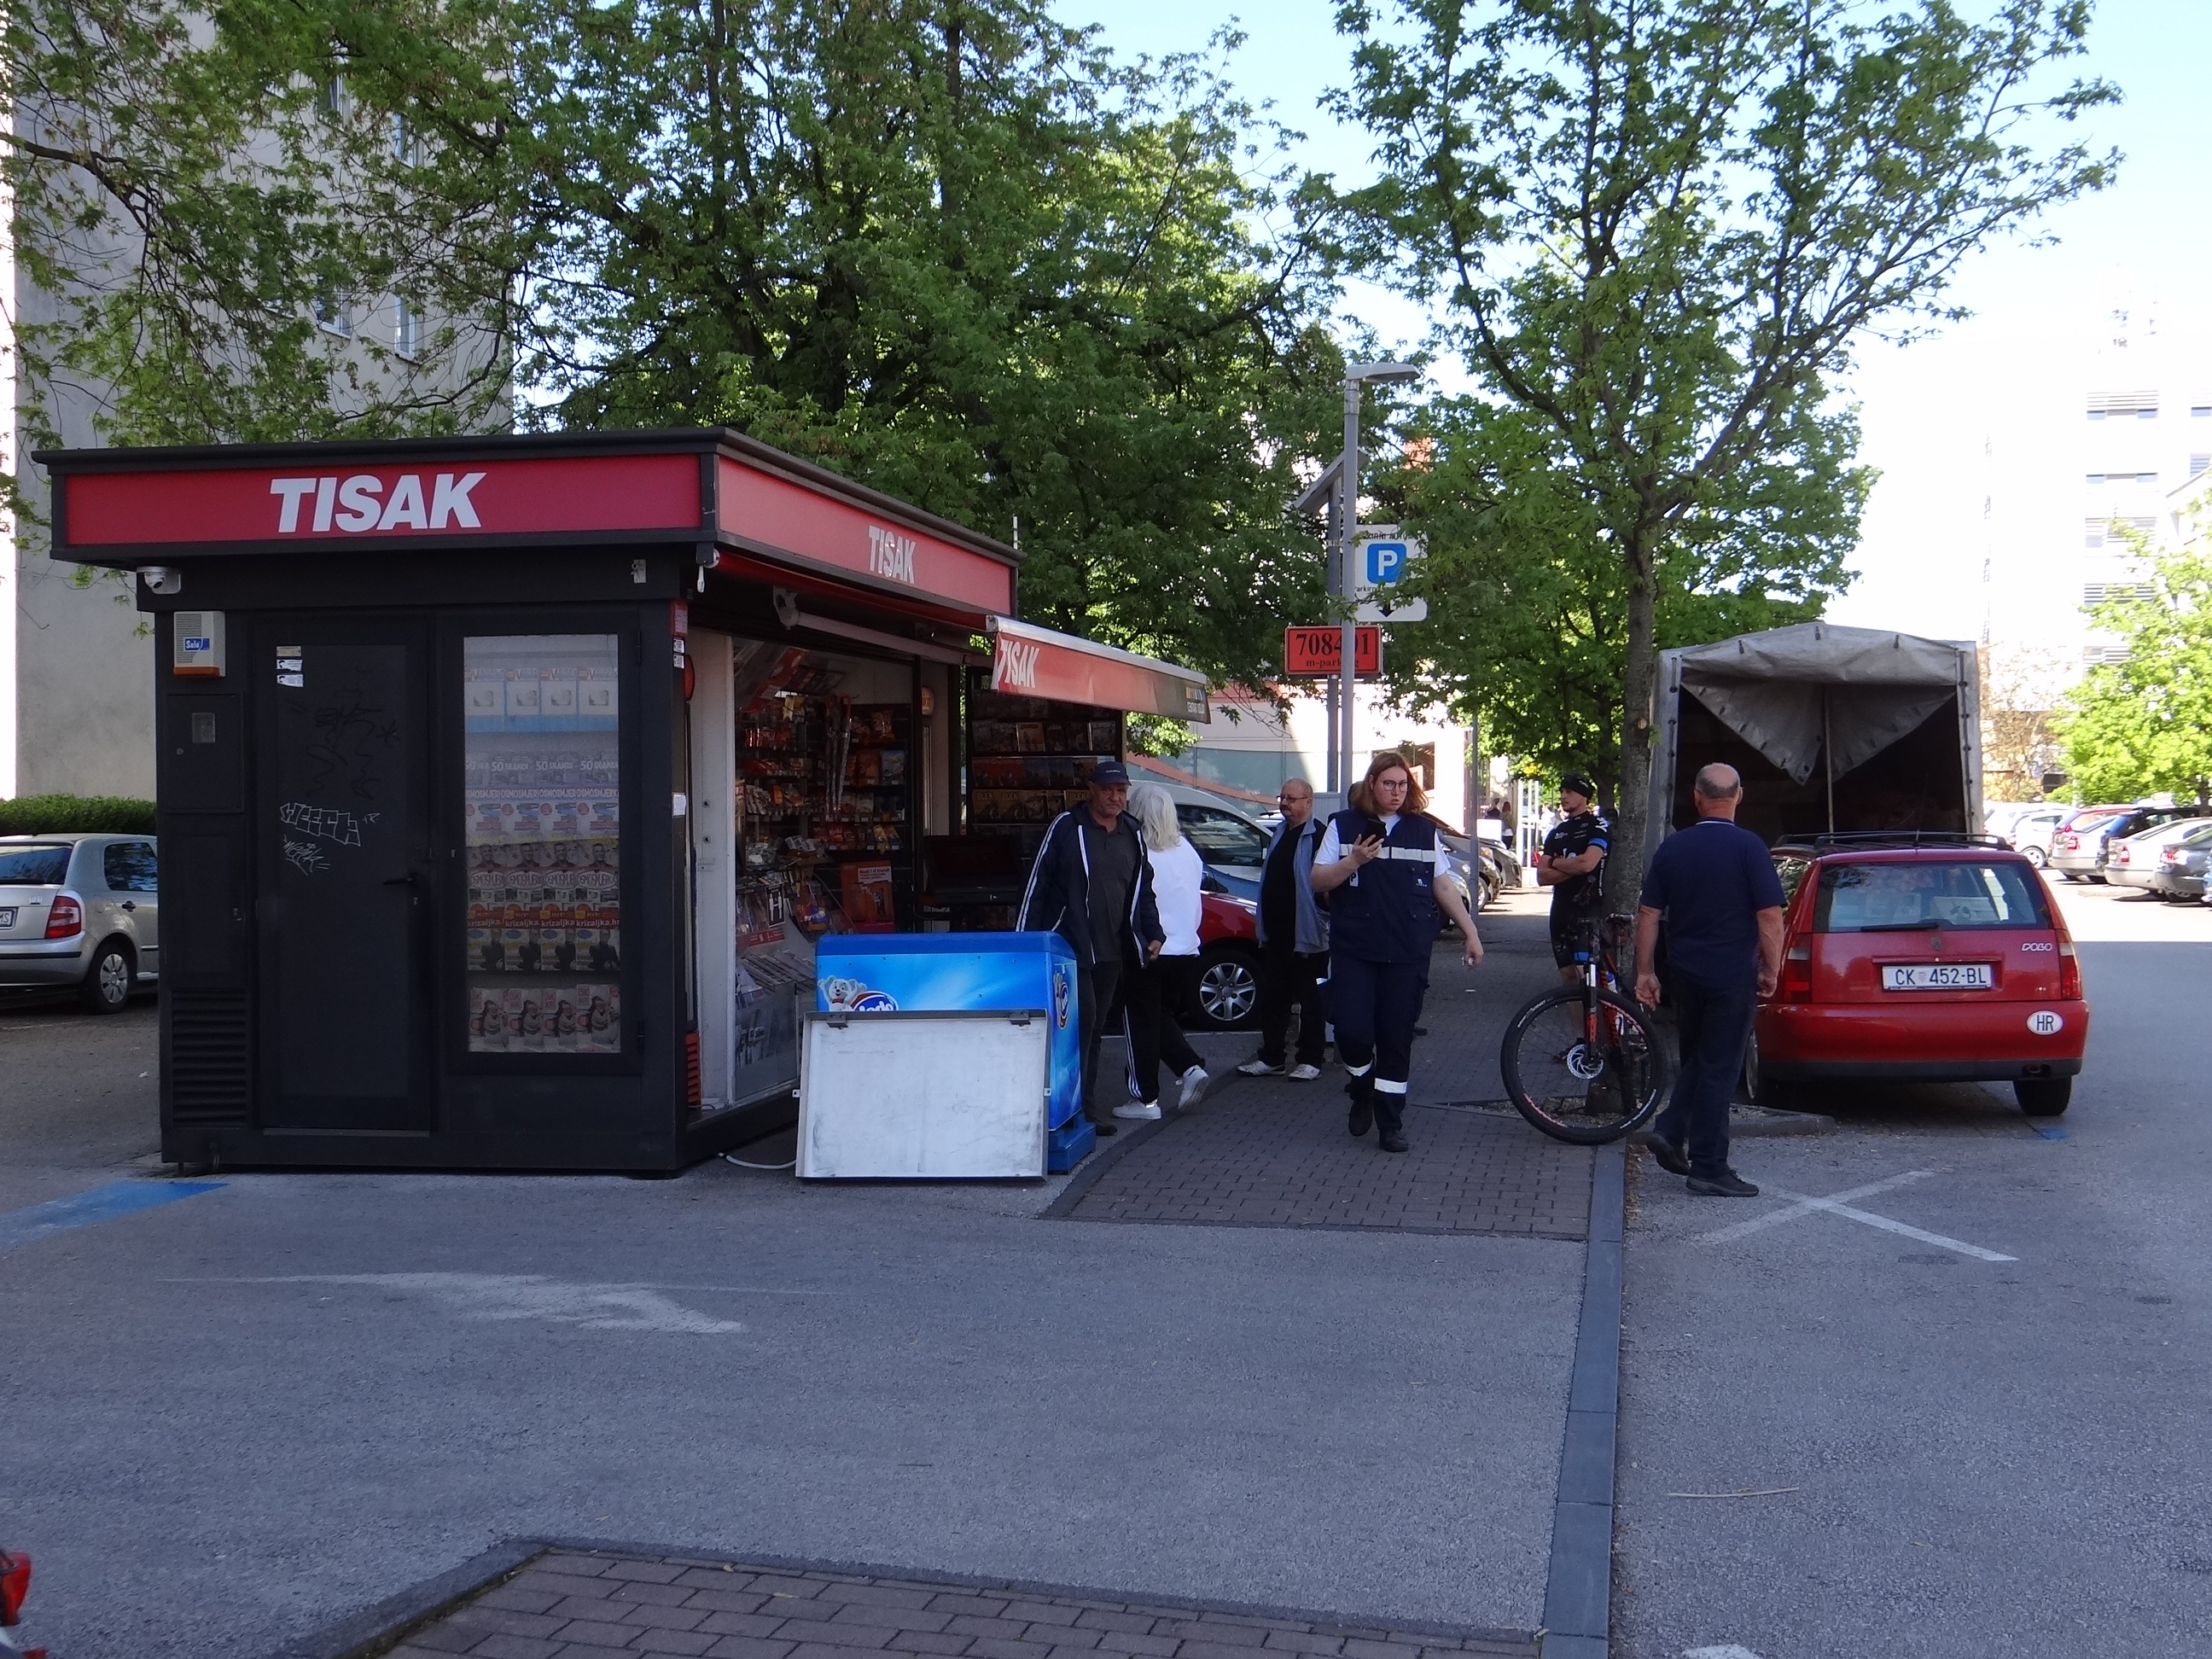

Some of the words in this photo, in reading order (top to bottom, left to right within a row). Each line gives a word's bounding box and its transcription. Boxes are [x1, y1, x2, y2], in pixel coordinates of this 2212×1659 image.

[270, 472, 486, 533] TISAK
[869, 525, 916, 584] TISAK
[1377, 550, 1398, 576] P
[994, 638, 1040, 690] TISAK
[2022, 942, 2053, 952] POLO
[1895, 969, 1916, 985] CK
[1929, 968, 1987, 985] 452-BL
[2036, 1015, 2054, 1031] HR
